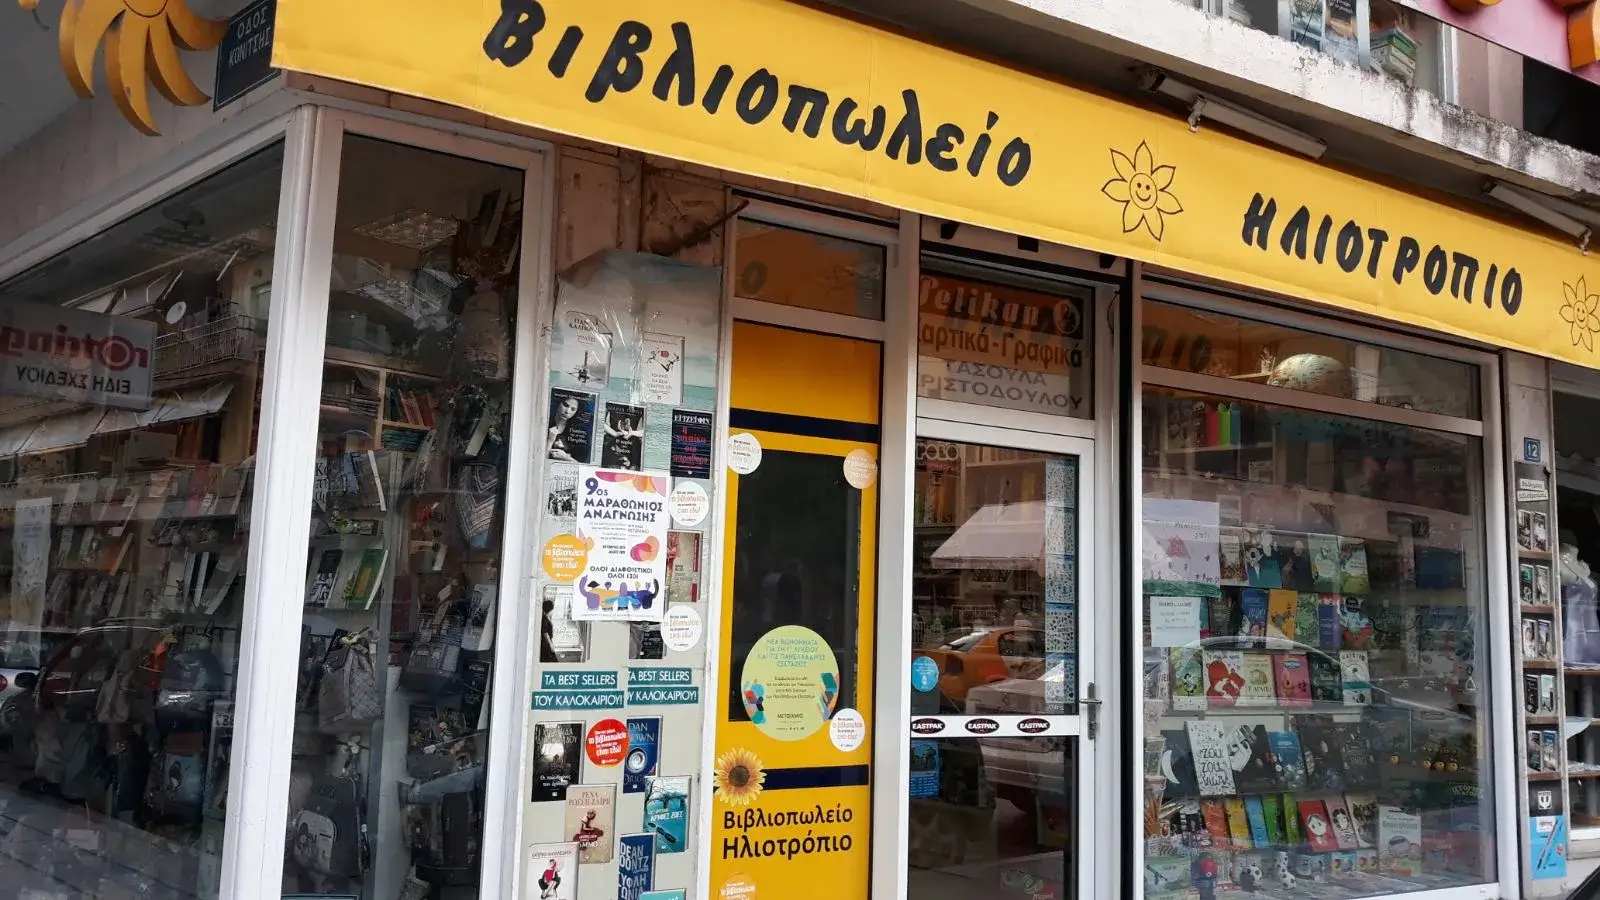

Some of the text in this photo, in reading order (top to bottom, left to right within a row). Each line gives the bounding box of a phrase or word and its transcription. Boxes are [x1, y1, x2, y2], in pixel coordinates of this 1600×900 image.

[237, 5, 268, 39] ΟΔΟΣ
[229, 26, 271, 67] ΚΟΝΙΤΣΗΣ
[483, 0, 1031, 187] Βιβλιοπωλείο
[1242, 192, 1523, 316] ΗΛΙΟΤΡΟΠΙΟ
[919, 276, 1039, 327] Pelikan
[918, 324, 1082, 370] αρτικά-Γραφικά
[919, 373, 1082, 409] ΡΙΣΤΟΔΟΥΛΟΥ
[1528, 444, 1538, 457] 12
[584, 498, 663, 512] ΜΑΡΑΘΩΝΙΟΣ
[584, 509, 656, 522] ΑΝΑΓΝΩΣΗΣ
[610, 566, 653, 574] ΔΙΑΦΟΡΕΤΙΚΟΙ
[545, 673, 616, 685] ΤΑ BEST SELLERS
[638, 671, 657, 681] BEST
[659, 670, 690, 681] SELLERS
[534, 695, 554, 706] ΤΟΥ
[556, 695, 622, 705] ΚΑΛΟΚΑΙΡΙΟΥ!
[635, 690, 697, 701] ΚΑΛΟΚΑΙΡΙΟΥ!
[628, 722, 648, 731] DAN
[724, 803, 853, 833] Βιβλιοπωλείο
[620, 842, 644, 860] DEAN
[722, 829, 853, 861] Ηλιοτρόπιο
[620, 855, 649, 871] OONTZ
[618, 873, 647, 889] ΥΦΛΗ
